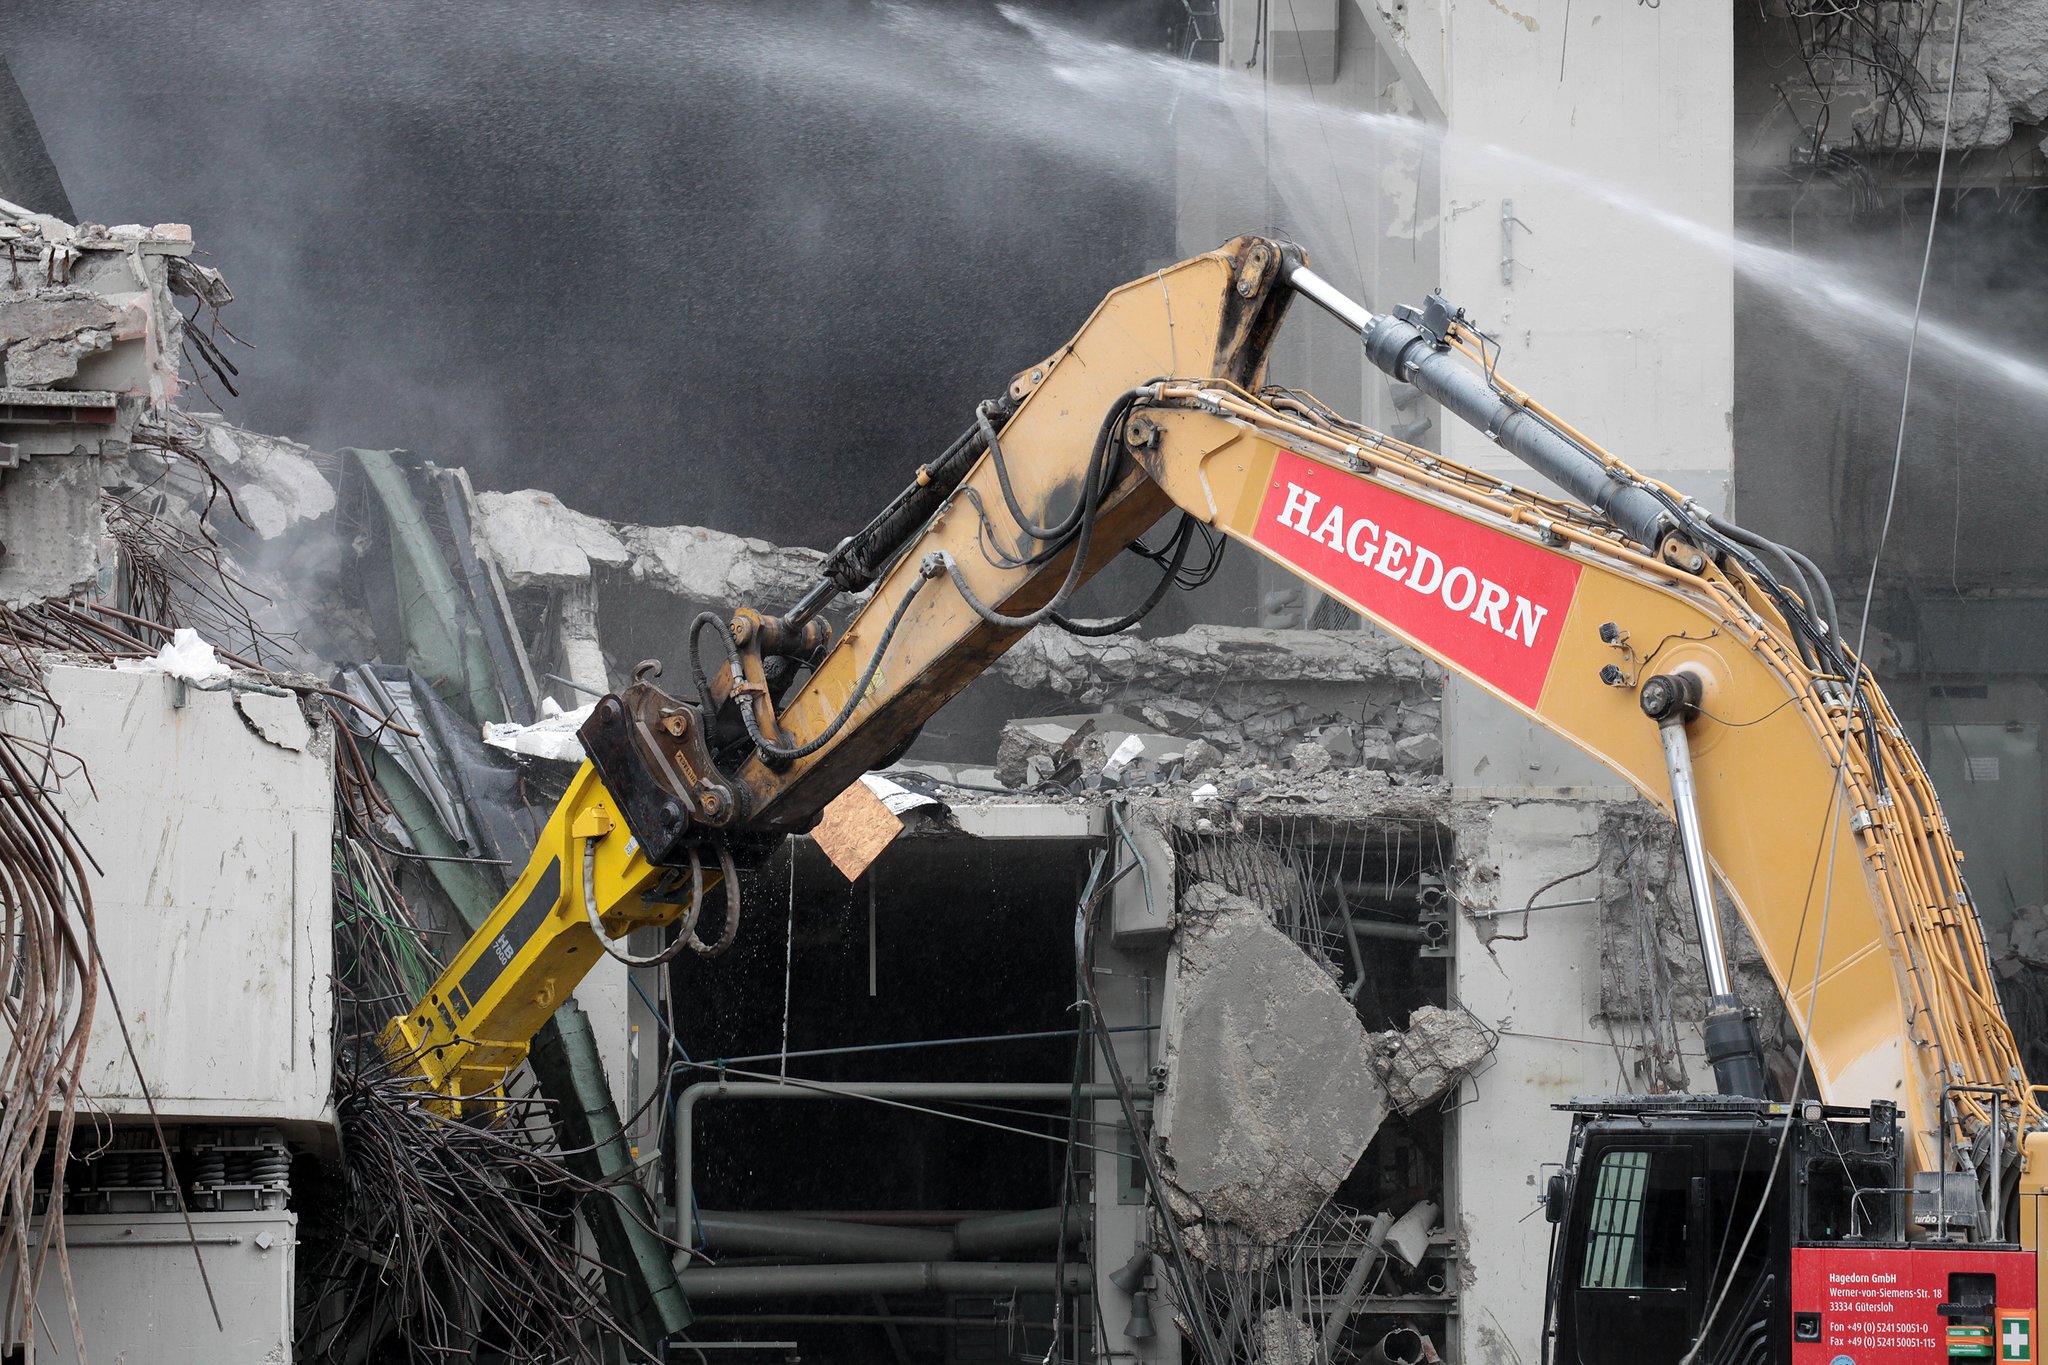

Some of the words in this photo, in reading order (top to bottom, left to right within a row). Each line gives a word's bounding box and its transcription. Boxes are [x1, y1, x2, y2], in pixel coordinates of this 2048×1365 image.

[1276, 481, 1549, 648] HAGEDORN
[498, 933, 514, 960] HB
[493, 941, 508, 966] 7000
[1914, 1214, 1937, 1223] turbo
[1829, 1272, 1869, 1285] Hagedorn
[1871, 1273, 1897, 1284] GmbH
[1829, 1287, 1931, 1299] Werner-von-Siemens-Str.
[1932, 1288, 1943, 1299] 18
[1829, 1301, 1853, 1312] 33334
[1855, 1301, 1894, 1312] Gütersloh
[1830, 1321, 1845, 1332] Fon
[1847, 1322, 1862, 1332] +49
[1863, 1321, 1876, 1335] (0)
[1876, 1323, 1895, 1333] 5241
[1830, 1336, 1844, 1346] Fax
[1847, 1336, 1862, 1346] +49
[1863, 1336, 1876, 1349] (0)
[1876, 1337, 1895, 1347] 5241
